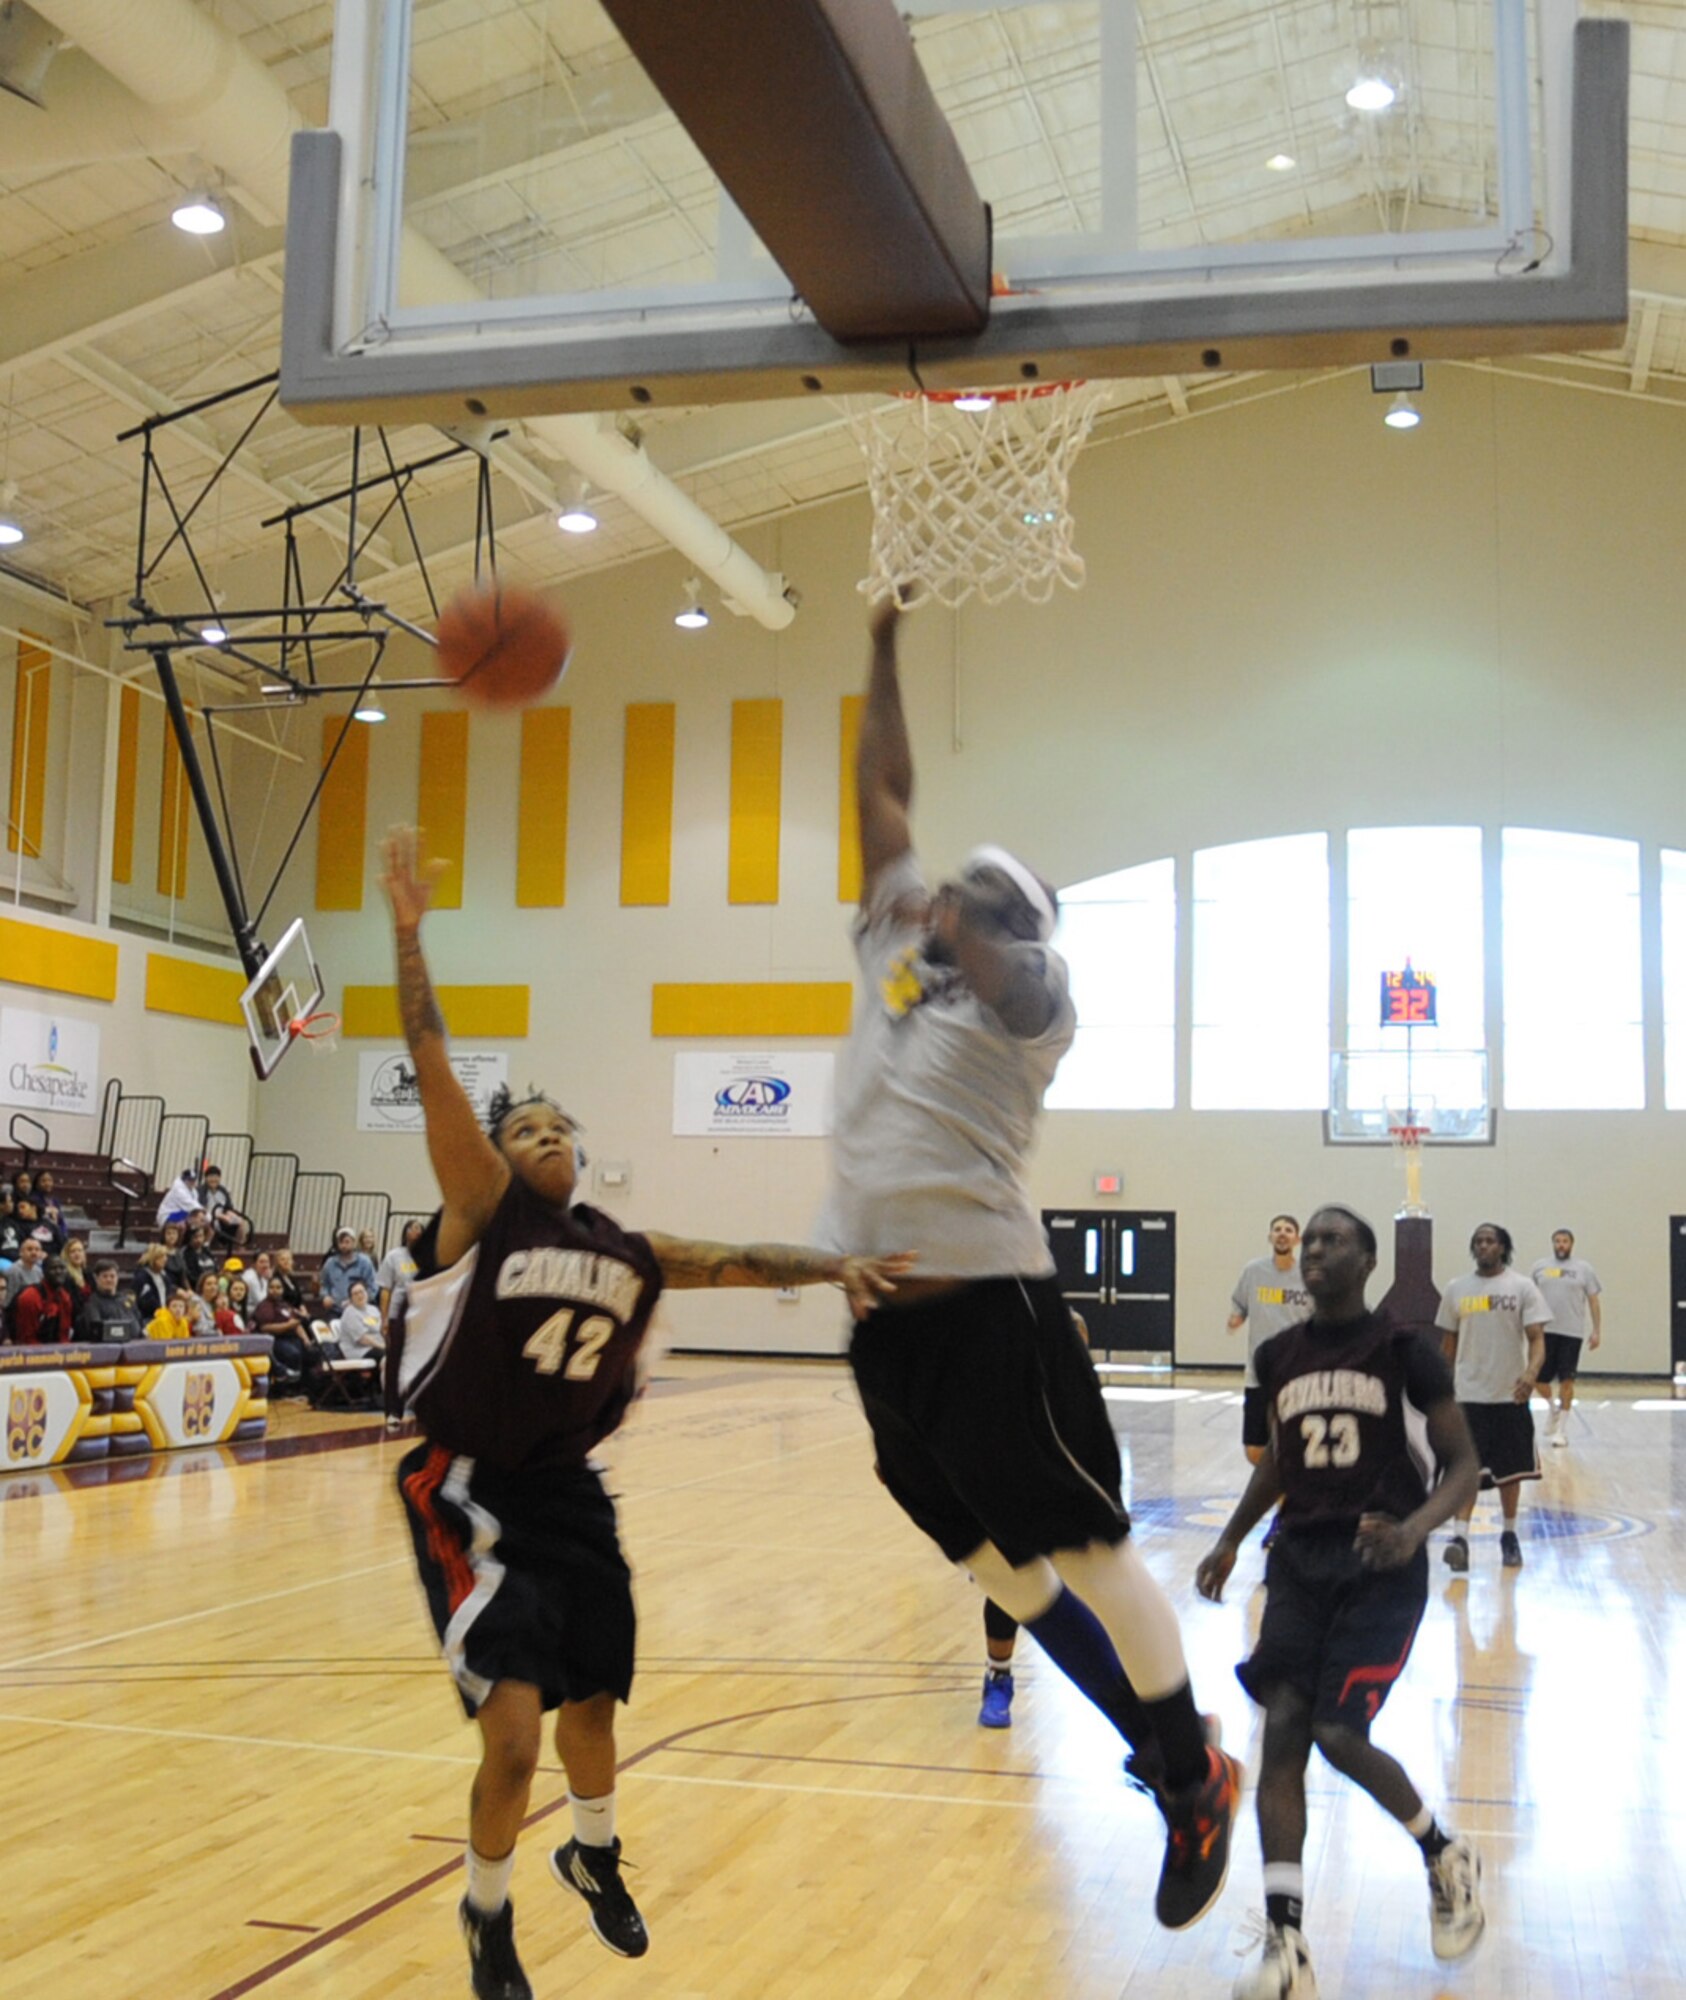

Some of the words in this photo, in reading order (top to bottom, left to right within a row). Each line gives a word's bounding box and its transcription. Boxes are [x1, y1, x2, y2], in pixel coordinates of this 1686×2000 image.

[1388, 989, 1429, 1022] 32
[9, 1062, 88, 1106] Chesapeake
[522, 1307, 616, 1381] 42
[1300, 1413, 1361, 1469] 23
